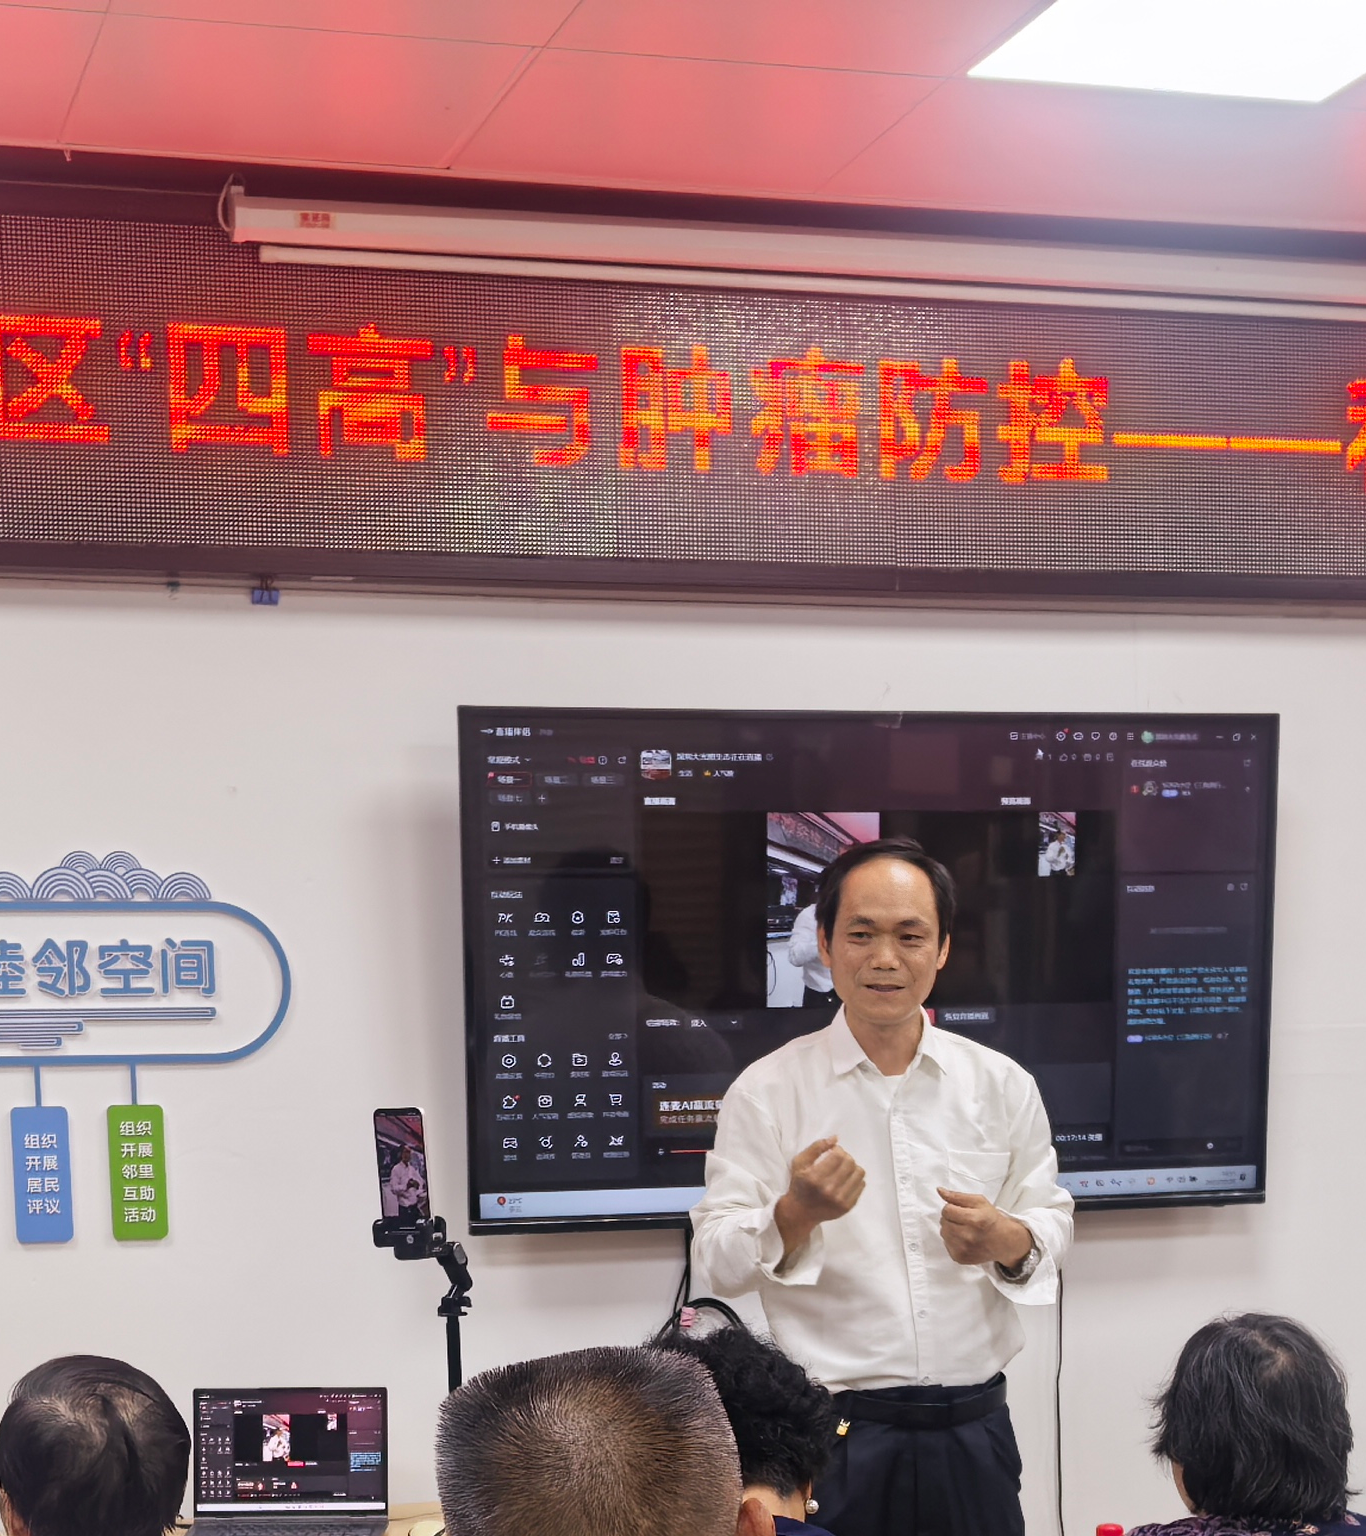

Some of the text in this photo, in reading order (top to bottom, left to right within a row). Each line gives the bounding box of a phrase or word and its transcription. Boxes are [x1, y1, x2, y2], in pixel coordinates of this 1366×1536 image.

[120, 1121, 152, 1136] 组织
[24, 1133, 57, 1149] 组织
[121, 1143, 153, 1158] 开展
[26, 1156, 58, 1172] 开展
[122, 1164, 155, 1180] 邻里
[27, 1177, 60, 1193] 居民
[123, 1186, 155, 1201] 互助
[28, 1199, 61, 1215] 评议
[124, 1207, 156, 1223] 活动
